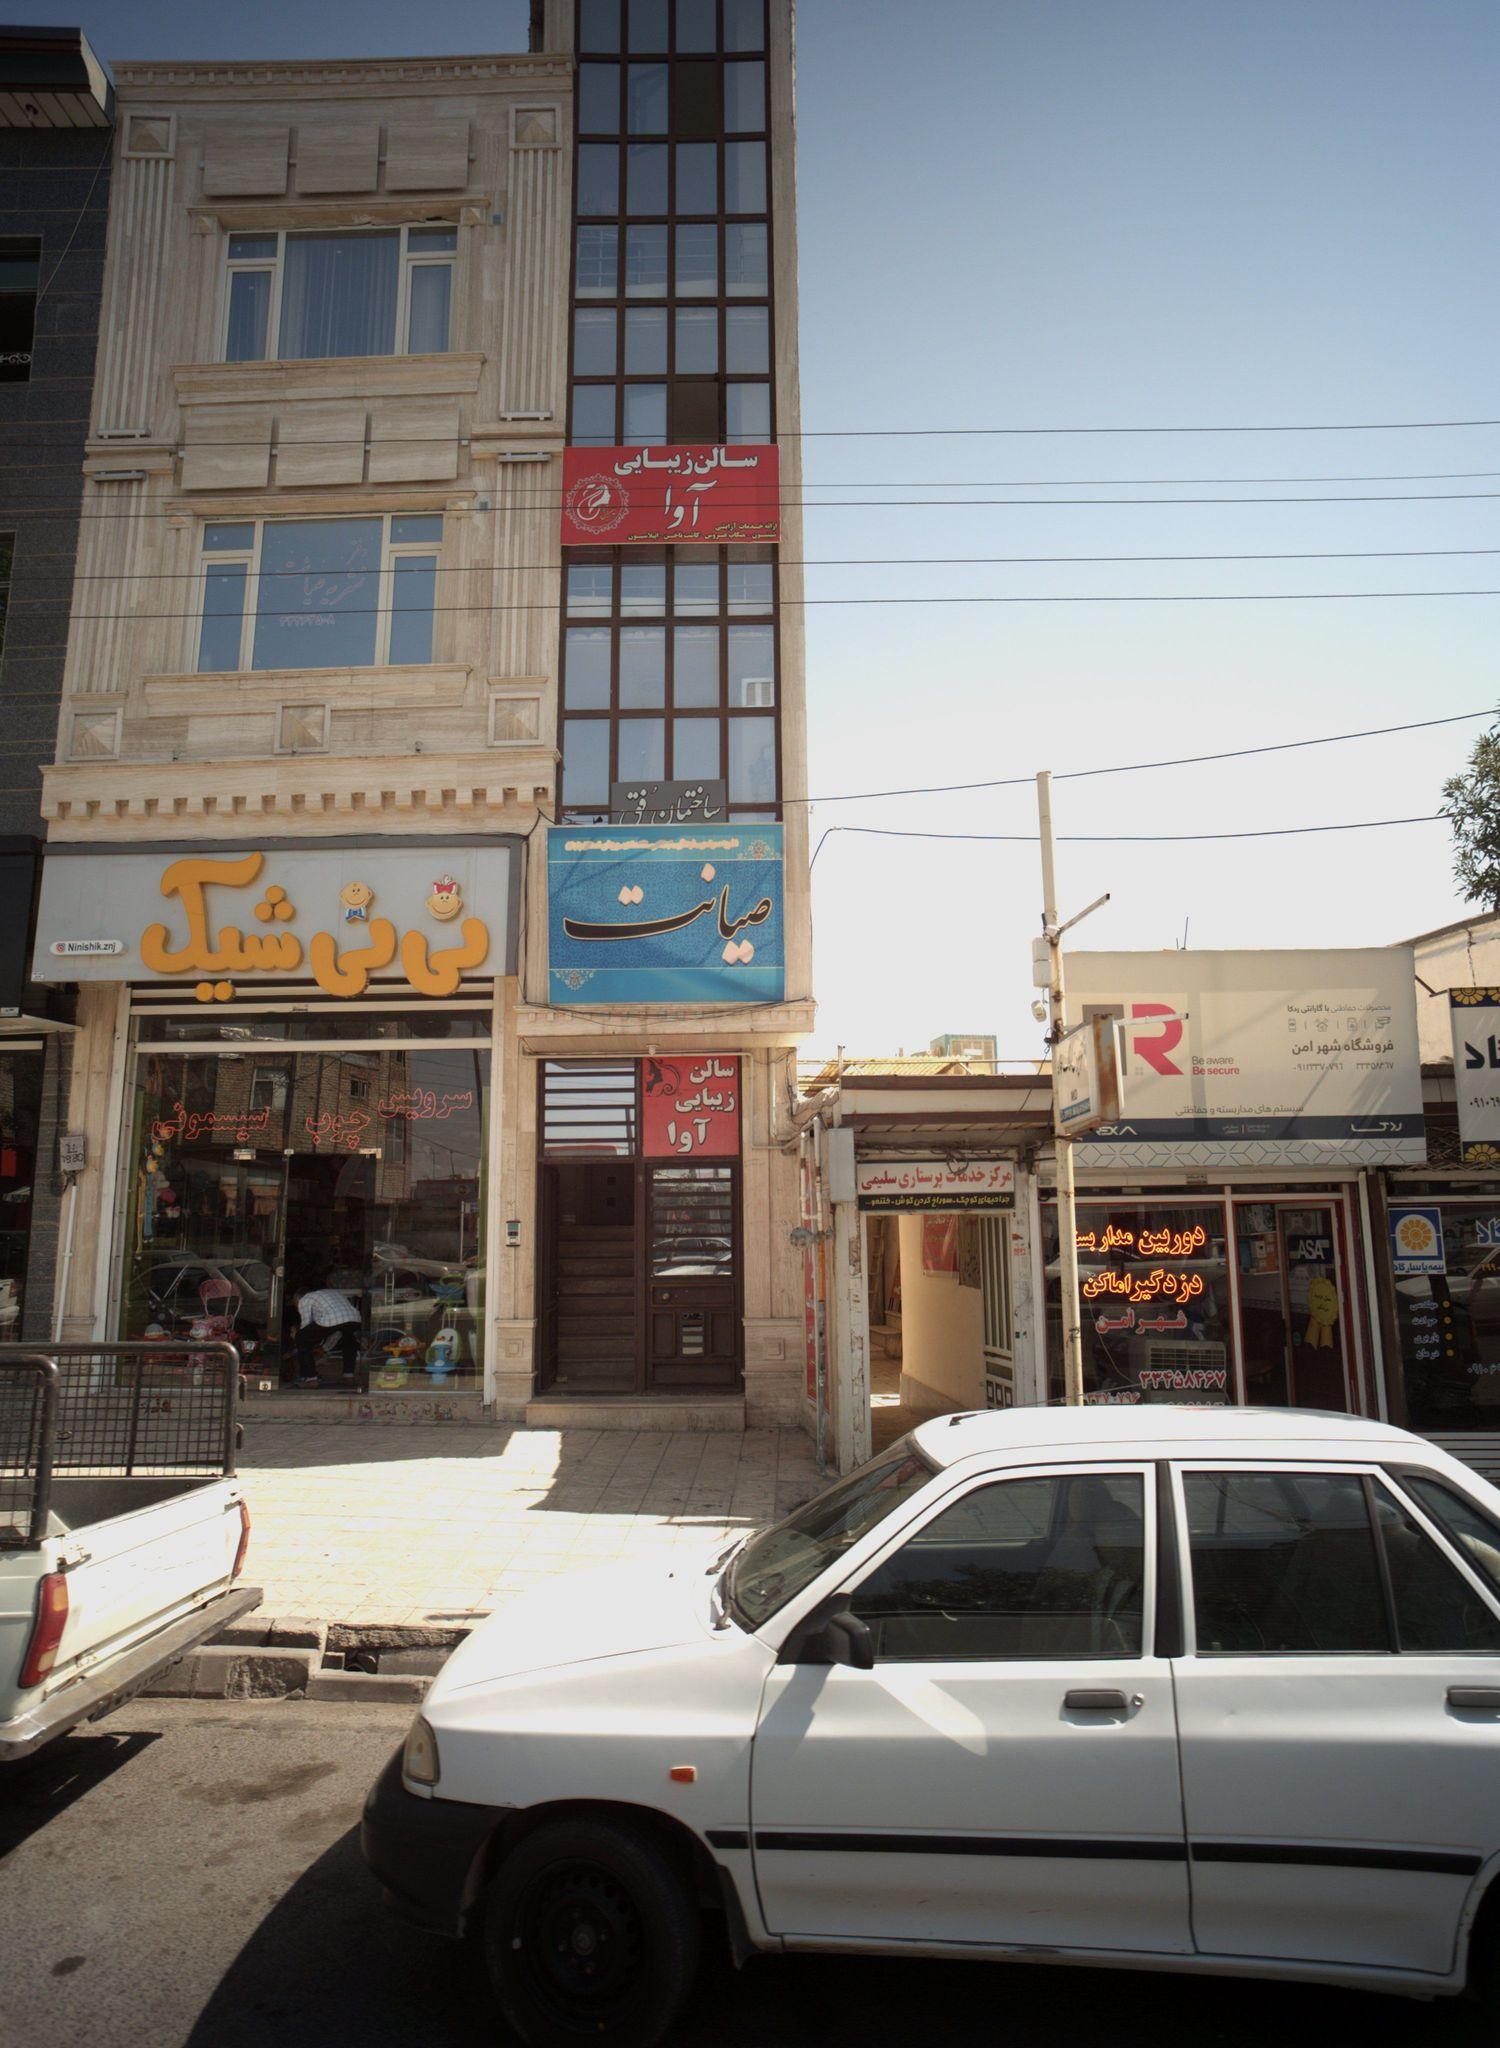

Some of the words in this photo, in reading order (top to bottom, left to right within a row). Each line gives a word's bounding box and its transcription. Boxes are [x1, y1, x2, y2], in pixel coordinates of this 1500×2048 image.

[613, 447, 693, 476] زیبایی
[693, 447, 759, 474] سالن
[663, 479, 718, 530] آوا
[67, 941, 116, 953] Ninishik.znj
[1291, 1040, 1313, 1056] امن
[1317, 1038, 1341, 1055] شهر
[1343, 1037, 1394, 1054] فروشگاه
[689, 1058, 735, 1084] سالن
[1192, 1056, 1205, 1066] Be
[1206, 1056, 1234, 1066] aware
[1192, 1066, 1206, 1076] Be
[1207, 1067, 1240, 1076] secure
[376, 1086, 473, 1119] سرویس
[674, 1087, 735, 1113] زیبایی
[666, 1117, 712, 1153] آوا
[861, 1170, 897, 1191] سلیمی
[898, 1167, 943, 1189] پرستاری
[945, 1166, 986, 1183] خدمات
[987, 1165, 1012, 1188] مرکز
[1100, 1225, 1133, 1252] مدار
[1138, 1225, 1205, 1255] دوربین
[1297, 1239, 1325, 1260] ASA
[1083, 1272, 1132, 1298] اماکن
[1095, 1307, 1136, 1335] امن
[1136, 1309, 1188, 1335] شهر
